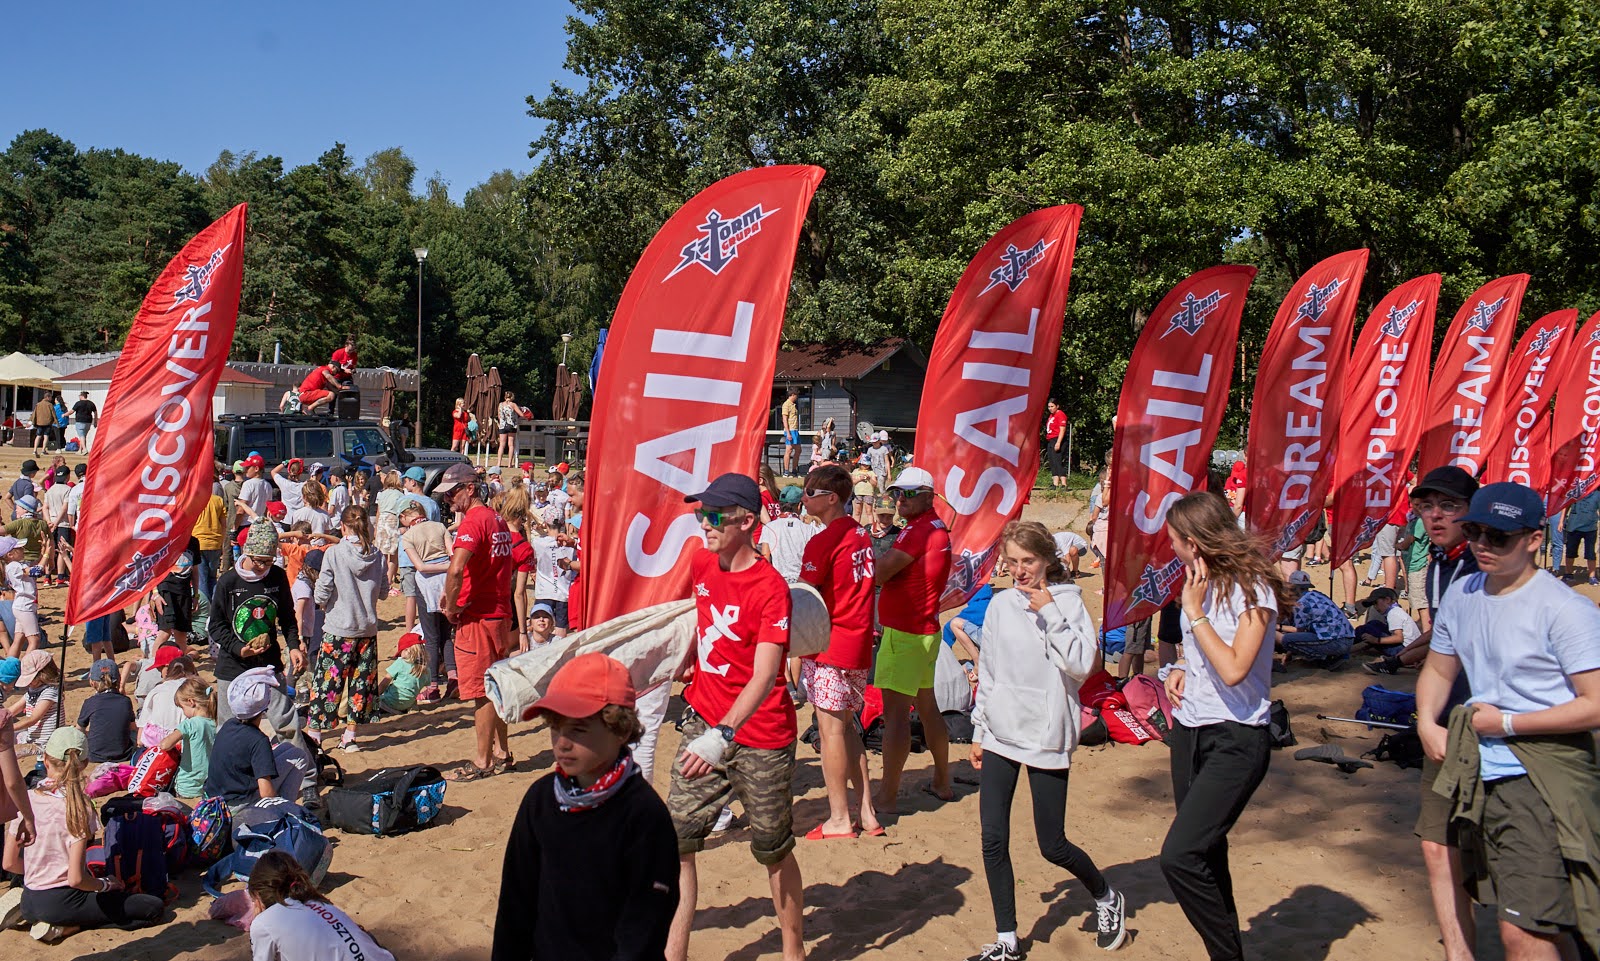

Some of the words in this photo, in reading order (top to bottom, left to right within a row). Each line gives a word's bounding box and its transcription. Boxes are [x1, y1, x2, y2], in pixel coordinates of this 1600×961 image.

[721, 223, 760, 250] GRUPA
[132, 301, 212, 540] DISCOVER
[625, 301, 755, 577] SAIL
[945, 308, 1040, 516] SAIL
[1134, 353, 1212, 535] SAIL
[1278, 327, 1332, 510] DREAM
[1365, 342, 1409, 508] EXPLORE
[1508, 356, 1551, 488] DISCOVER
[1493, 504, 1522, 516] AMERICAN
[128, 751, 155, 790] SAILING
[305, 903, 366, 961] AHOJSZTOR
